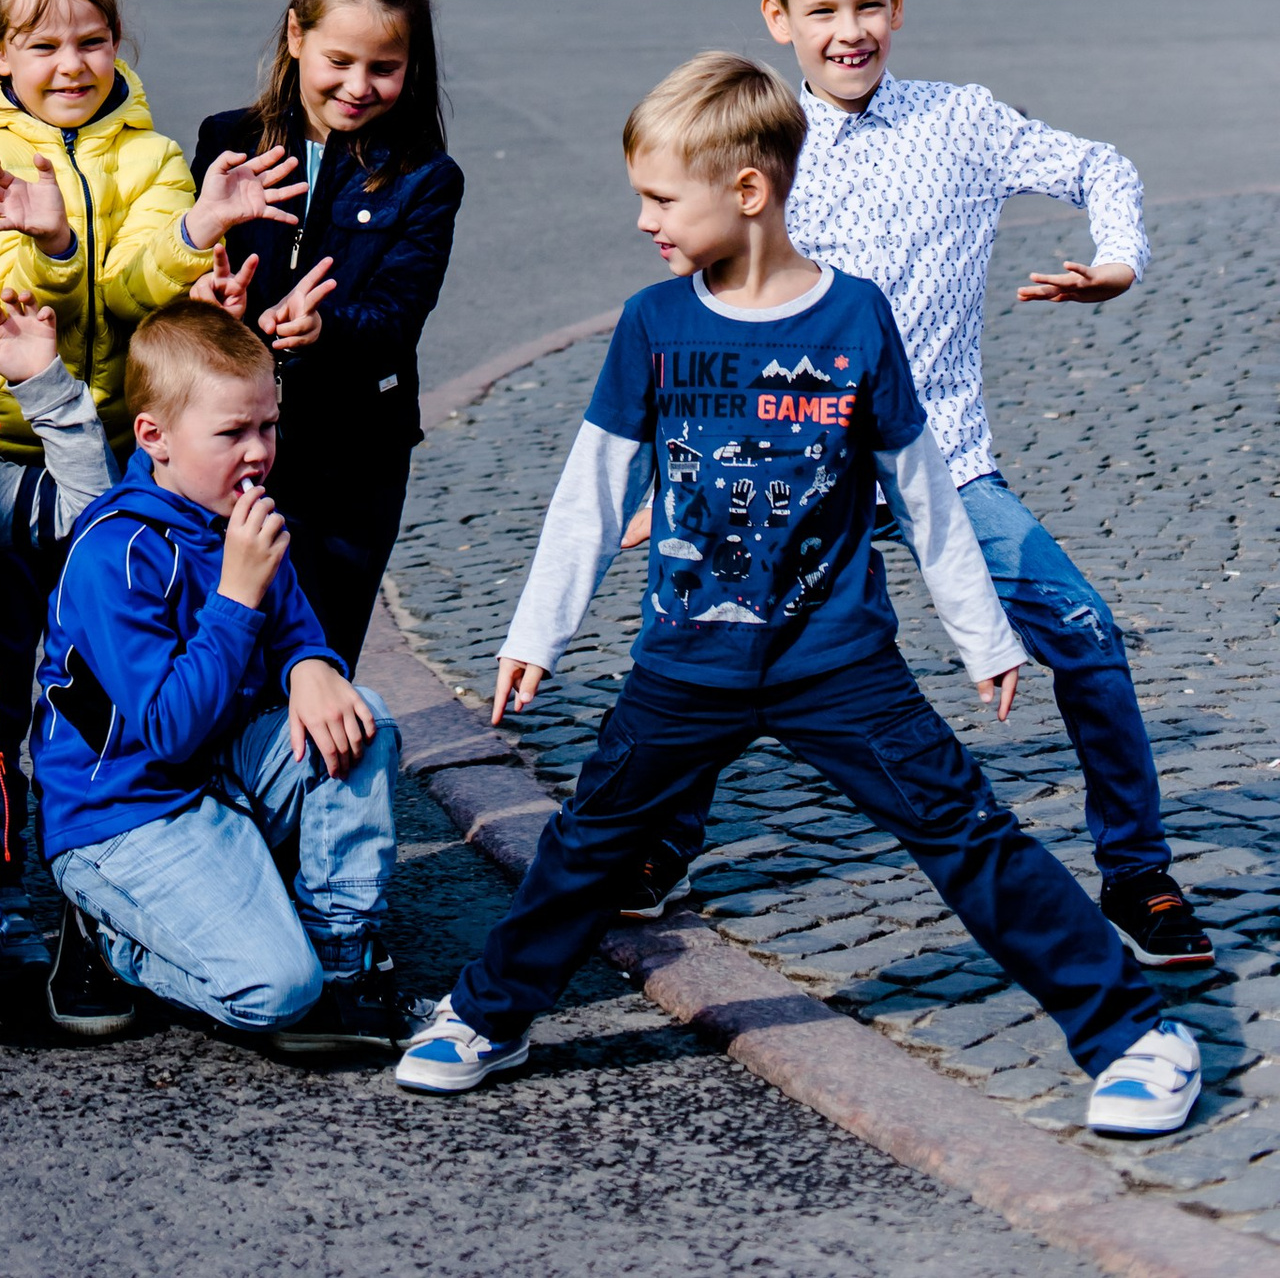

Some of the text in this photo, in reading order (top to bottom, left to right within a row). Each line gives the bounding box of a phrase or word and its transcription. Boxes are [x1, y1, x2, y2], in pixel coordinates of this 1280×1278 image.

[652, 351, 741, 389] I LIKE
[657, 393, 857, 428] WINTER GAMES
